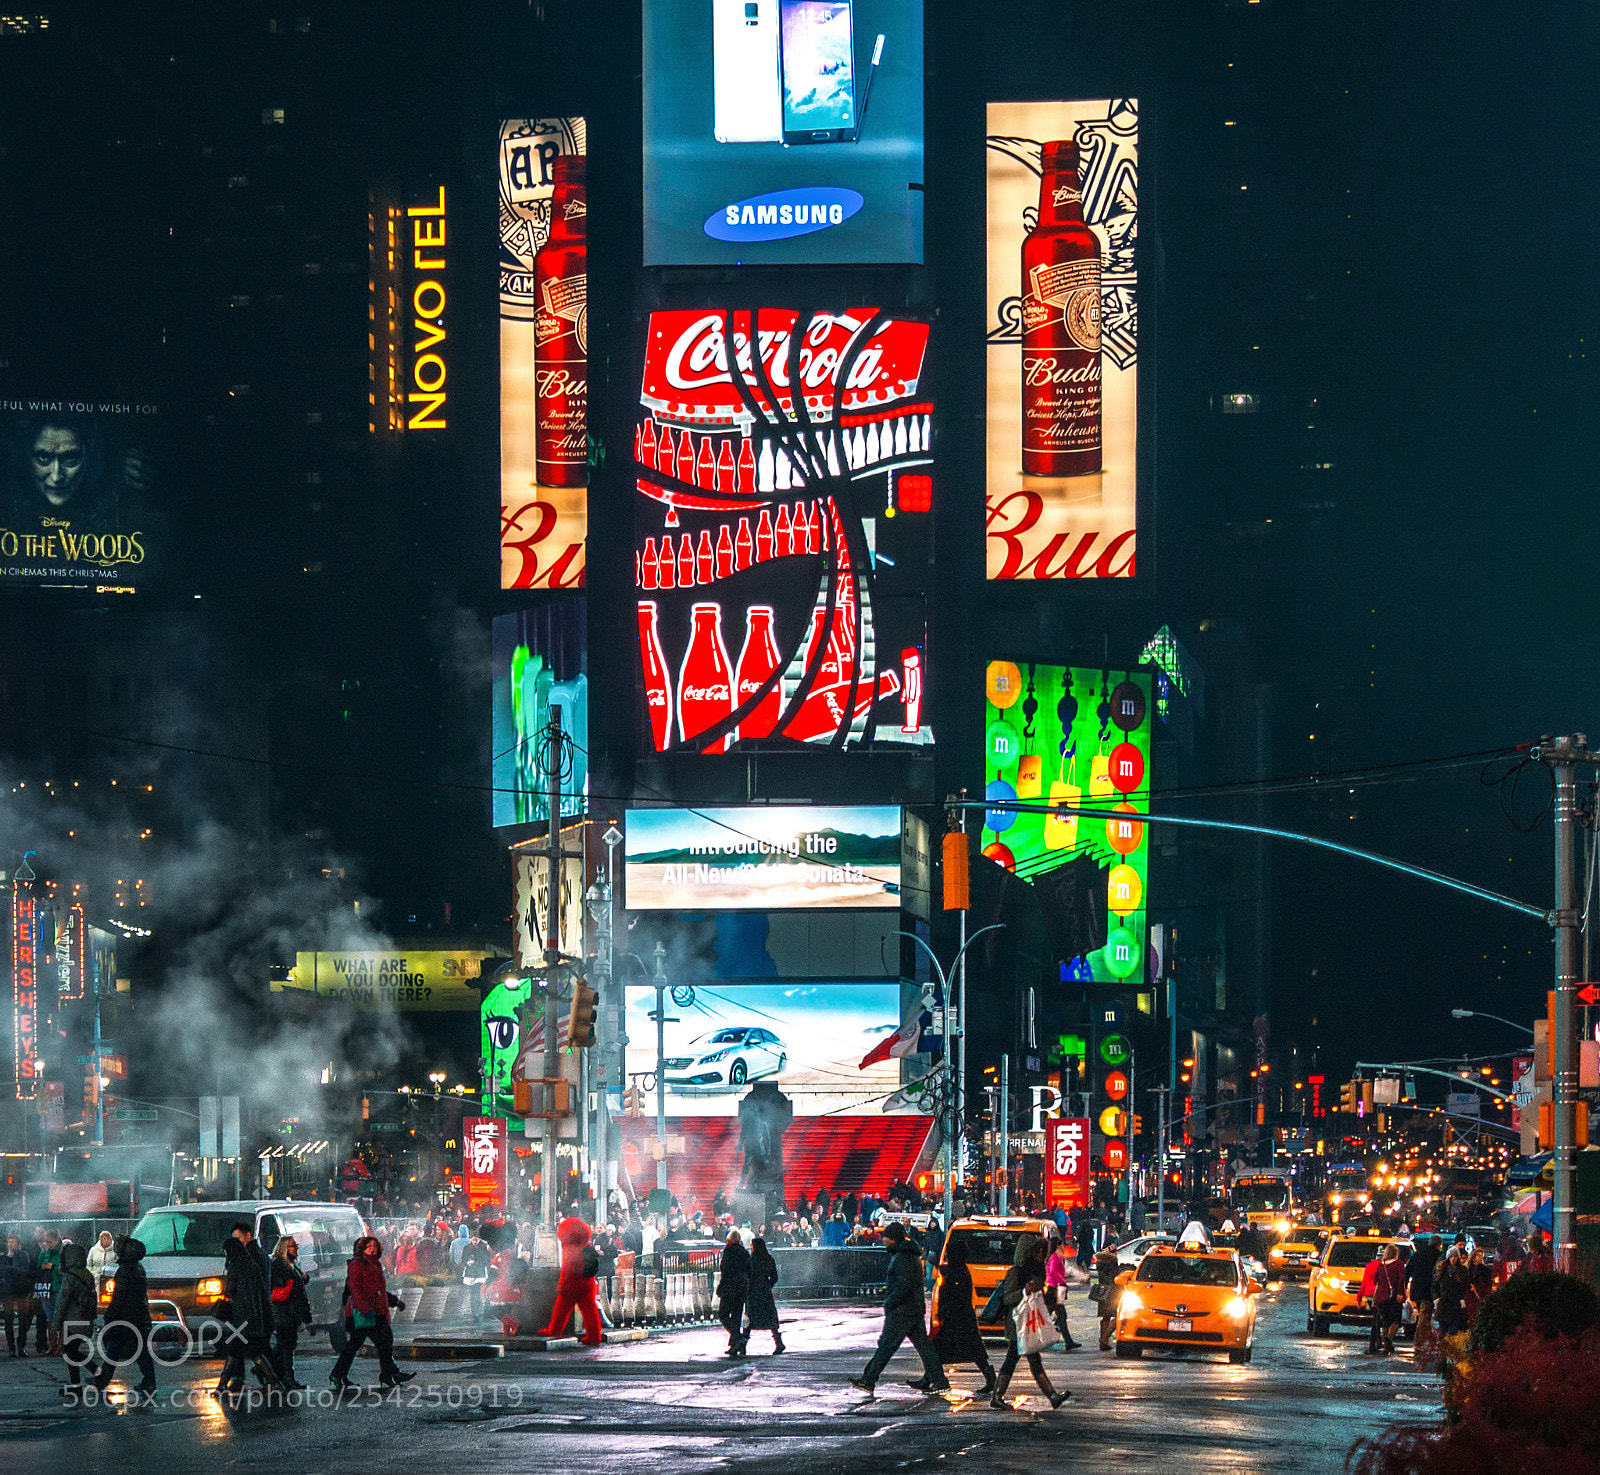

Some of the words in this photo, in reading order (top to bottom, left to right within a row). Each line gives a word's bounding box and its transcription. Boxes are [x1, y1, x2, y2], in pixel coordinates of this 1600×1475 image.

[726, 205, 843, 225] SAMSUNG
[407, 185, 447, 430] NOVOTEL
[665, 315, 892, 390] Coca-Cola
[0, 401, 23, 411] FUL
[28, 401, 63, 412] WHAT
[68, 402, 94, 413] YOU
[99, 404, 130, 414] WISH
[136, 404, 159, 415] FOR
[40, 516, 71, 530] Disney
[20, 534, 58, 558] THE
[58, 529, 145, 565] WOODS
[9, 567, 48, 577] CINEMAS
[49, 568, 67, 578] THIS
[804, 833, 838, 855] the
[333, 959, 375, 972] WHAT
[379, 959, 407, 972] ARE
[18, 900, 35, 1078] HERSHEY'S
[344, 974, 374, 987] YOU
[379, 974, 424, 987] DOING
[329, 988, 374, 1001] DOWN
[379, 988, 432, 1001] THERE?
[474, 1123, 500, 1174] tkts
[1056, 1123, 1083, 1175] tkts
